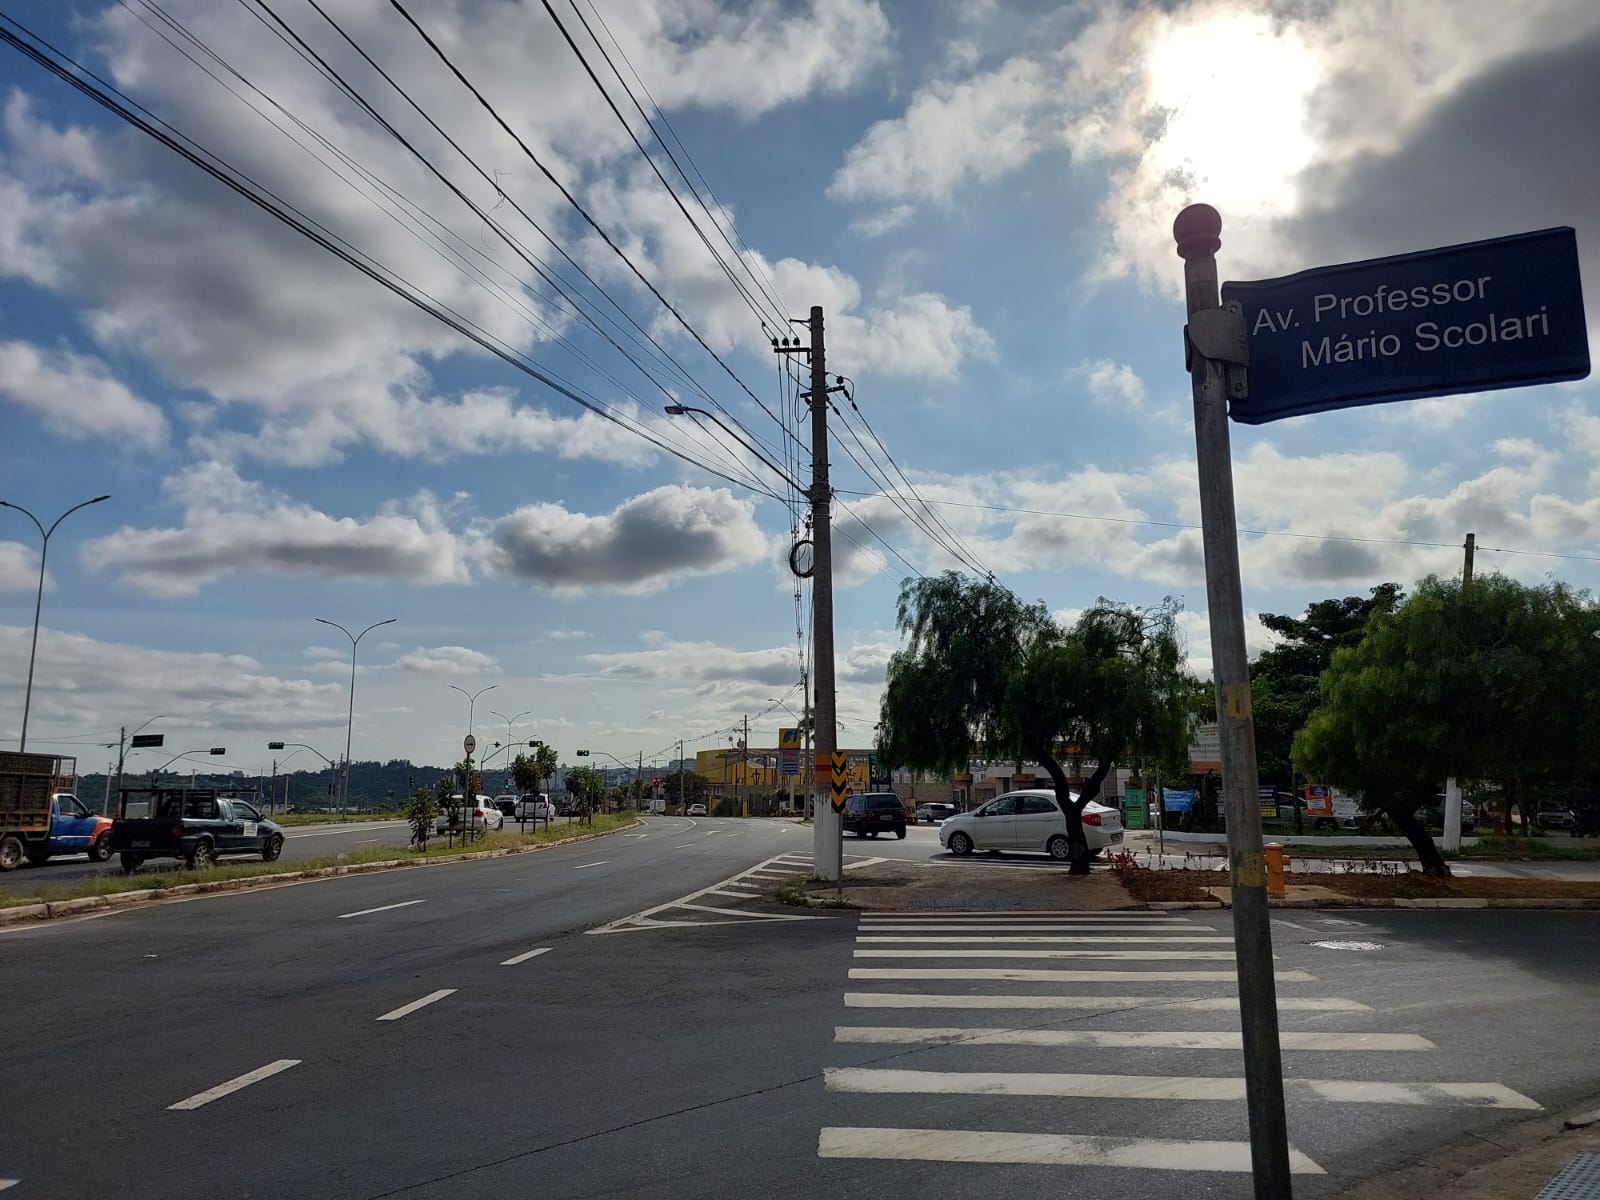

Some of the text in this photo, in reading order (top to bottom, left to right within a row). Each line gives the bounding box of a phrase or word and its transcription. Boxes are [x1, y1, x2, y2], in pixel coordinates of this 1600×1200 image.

[1252, 275, 1491, 336] Av. Professor
[1302, 306, 1550, 369] Mário Scolari
